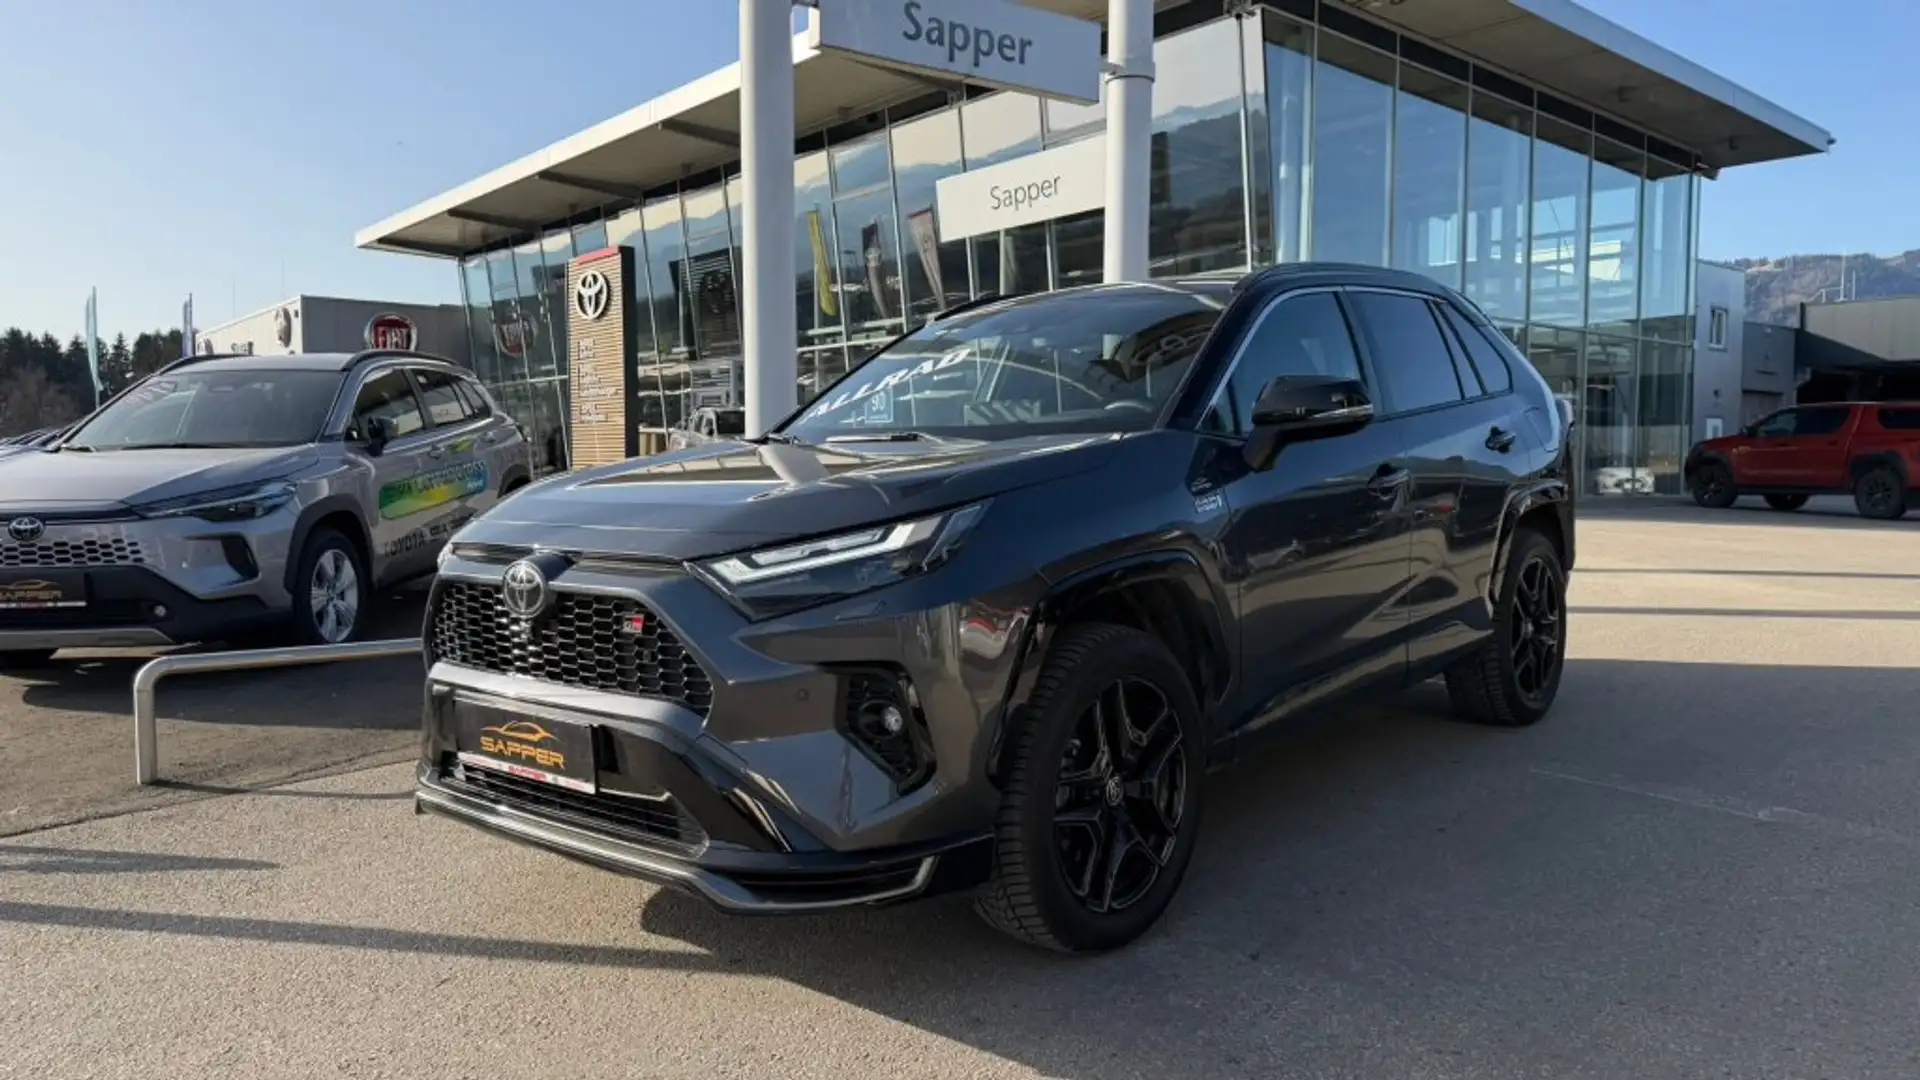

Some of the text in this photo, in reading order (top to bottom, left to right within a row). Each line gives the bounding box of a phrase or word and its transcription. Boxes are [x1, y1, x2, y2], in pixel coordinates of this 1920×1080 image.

[902, 1, 1033, 68] Sapper
[989, 176, 1061, 211] Sapper
[799, 348, 971, 425] ALLRAD
[479, 736, 566, 770] SAPPER
